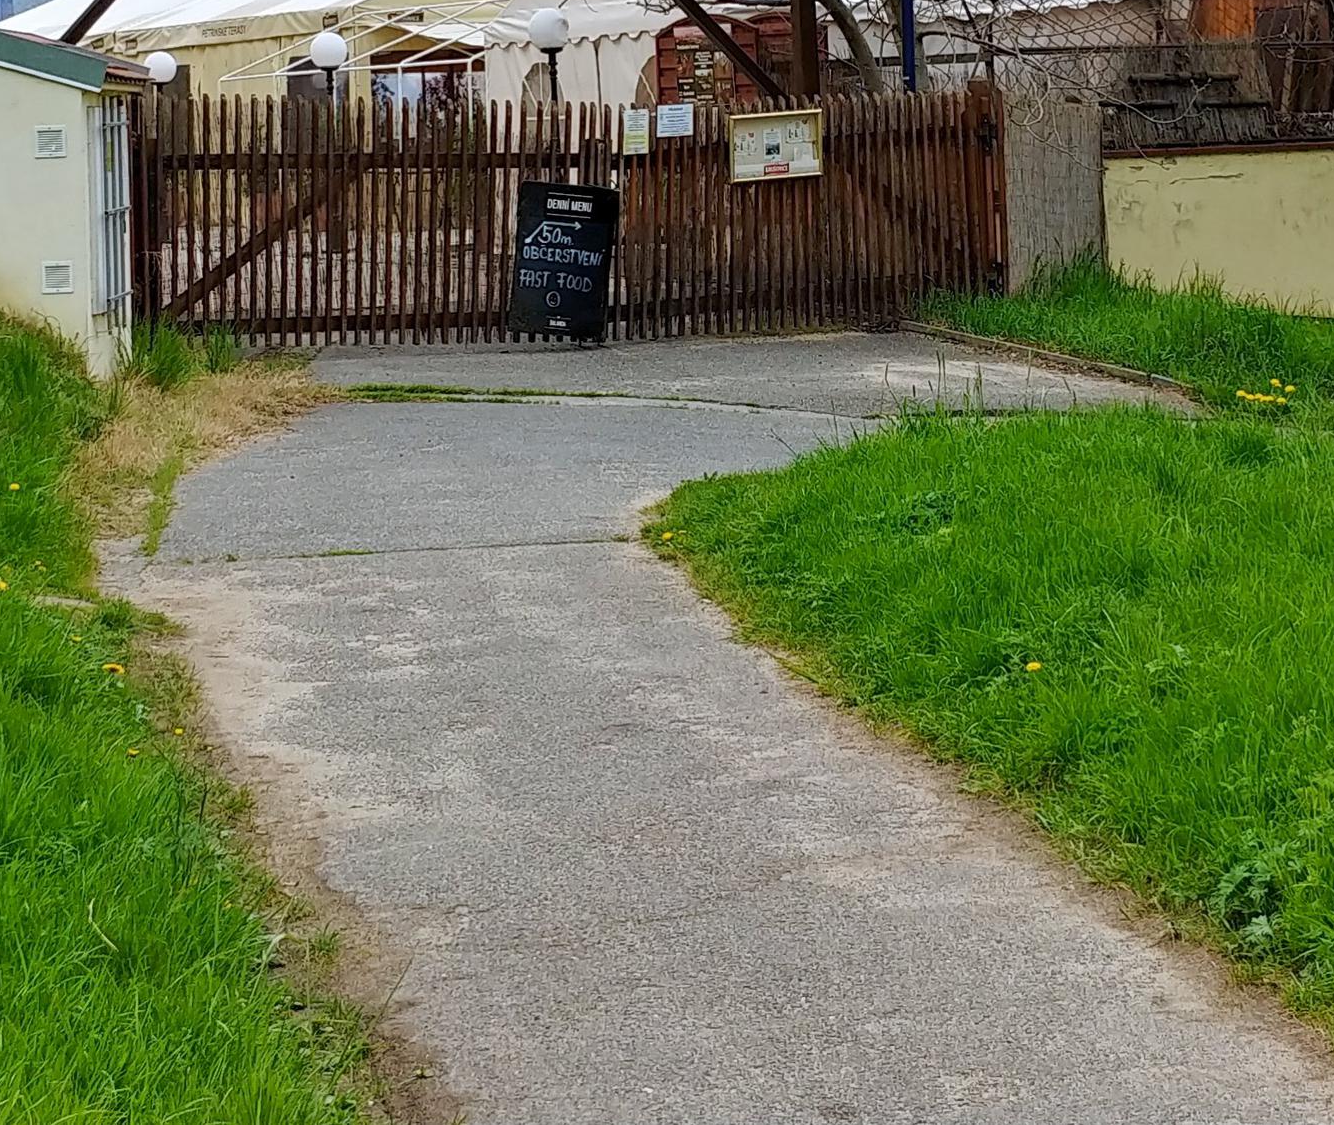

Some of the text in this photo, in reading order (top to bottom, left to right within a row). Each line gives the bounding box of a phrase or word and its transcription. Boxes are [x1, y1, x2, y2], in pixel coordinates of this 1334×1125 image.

[546, 198, 593, 213] DENNÍ MENU
[522, 244, 605, 266] OBČERSTVENÍ
[519, 268, 593, 292] FAST FOOD
